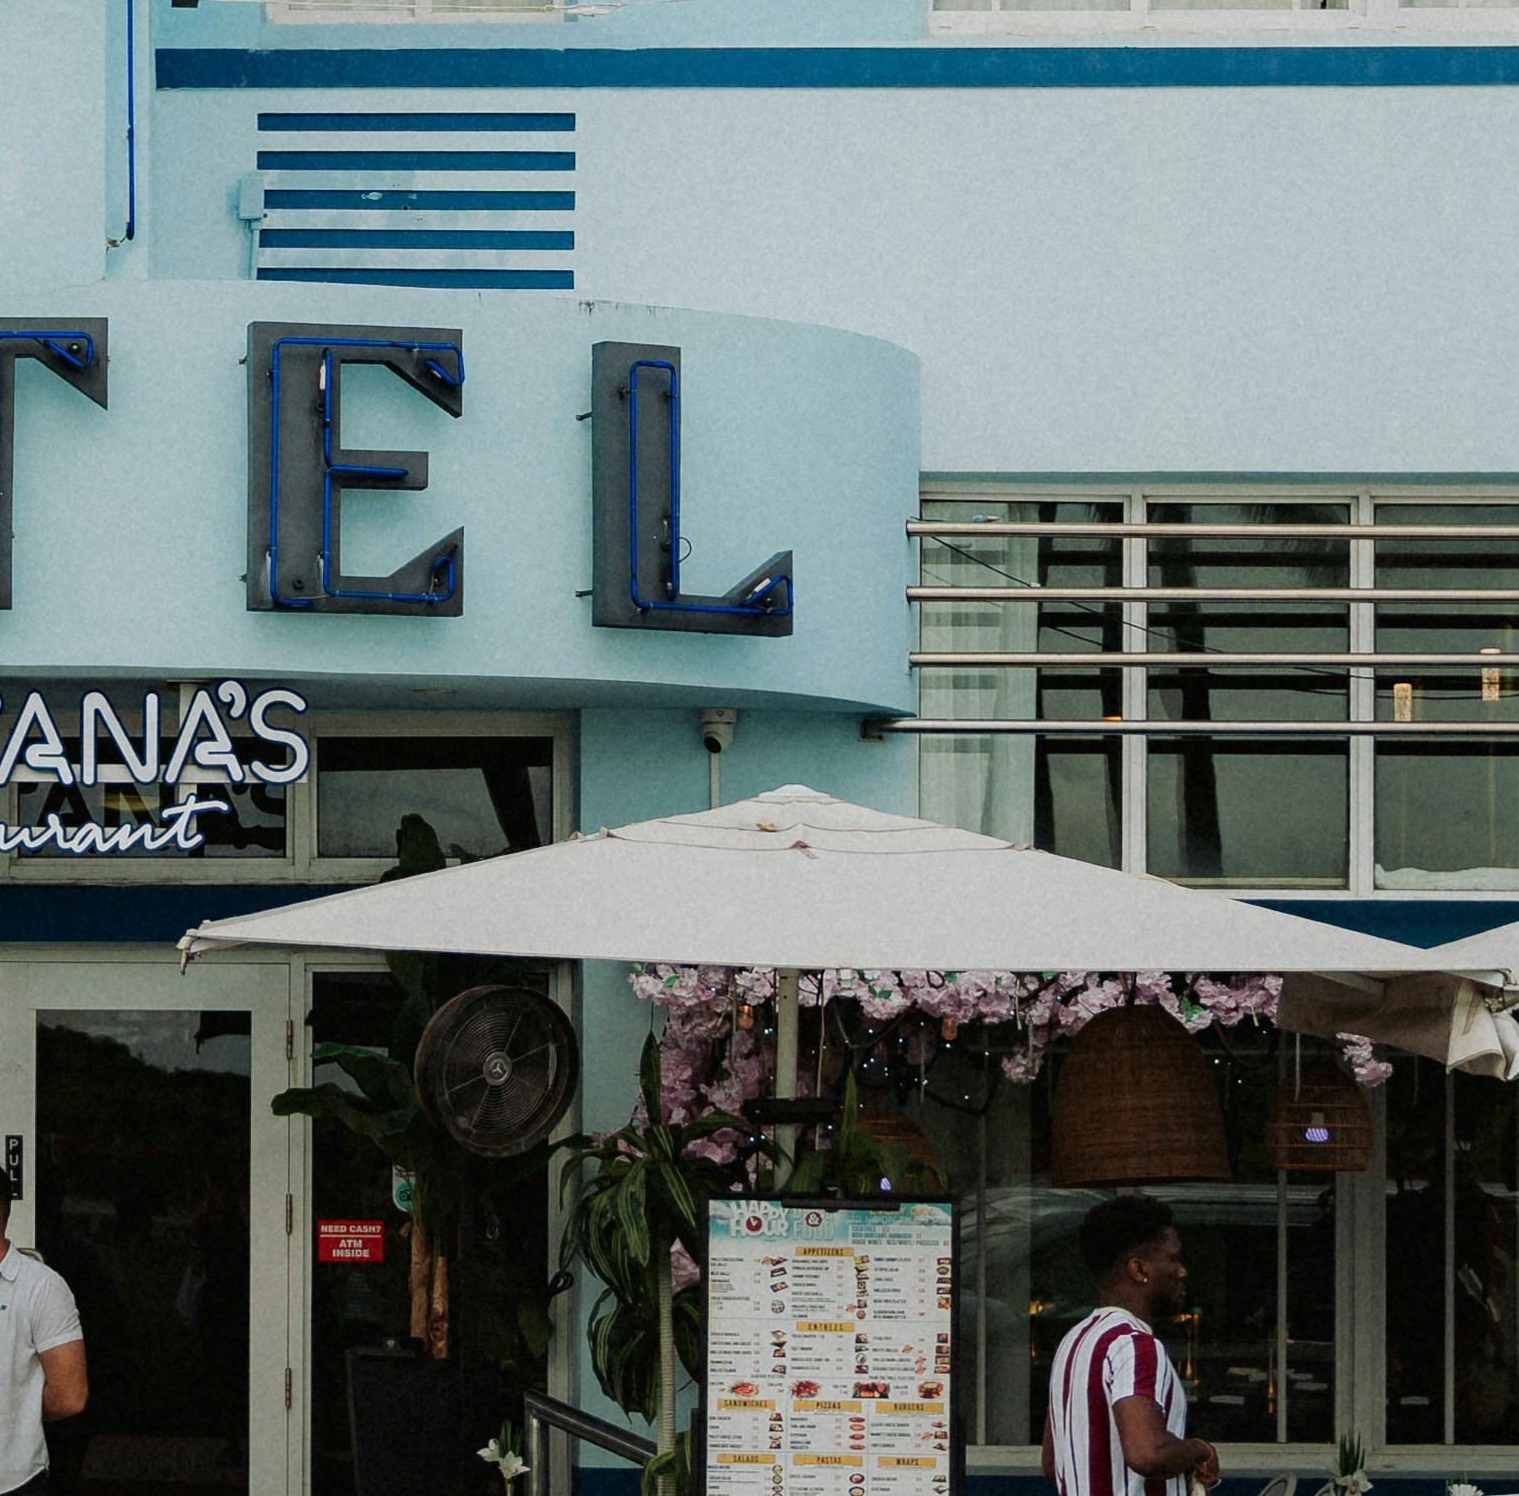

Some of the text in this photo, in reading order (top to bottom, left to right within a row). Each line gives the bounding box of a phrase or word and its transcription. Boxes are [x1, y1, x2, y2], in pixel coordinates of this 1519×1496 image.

[9, 1138, 19, 1196] PUL
[729, 1200, 790, 1220] HAPPY
[321, 1225, 382, 1233] NEED CASH?
[730, 1216, 790, 1238] HOUR
[793, 1220, 835, 1241] FOOD
[339, 1239, 363, 1248] ATM
[332, 1249, 369, 1258] INSIDE
[802, 1247, 845, 1256] APPETIZERS
[724, 1399, 769, 1409] SANDWICHES
[816, 1401, 842, 1410] PIZZAS
[893, 1403, 925, 1412] BURGERS
[733, 1455, 759, 1464] SALADS
[817, 1456, 842, 1465] PASTAS
[896, 1458, 920, 1467] WRAPS
